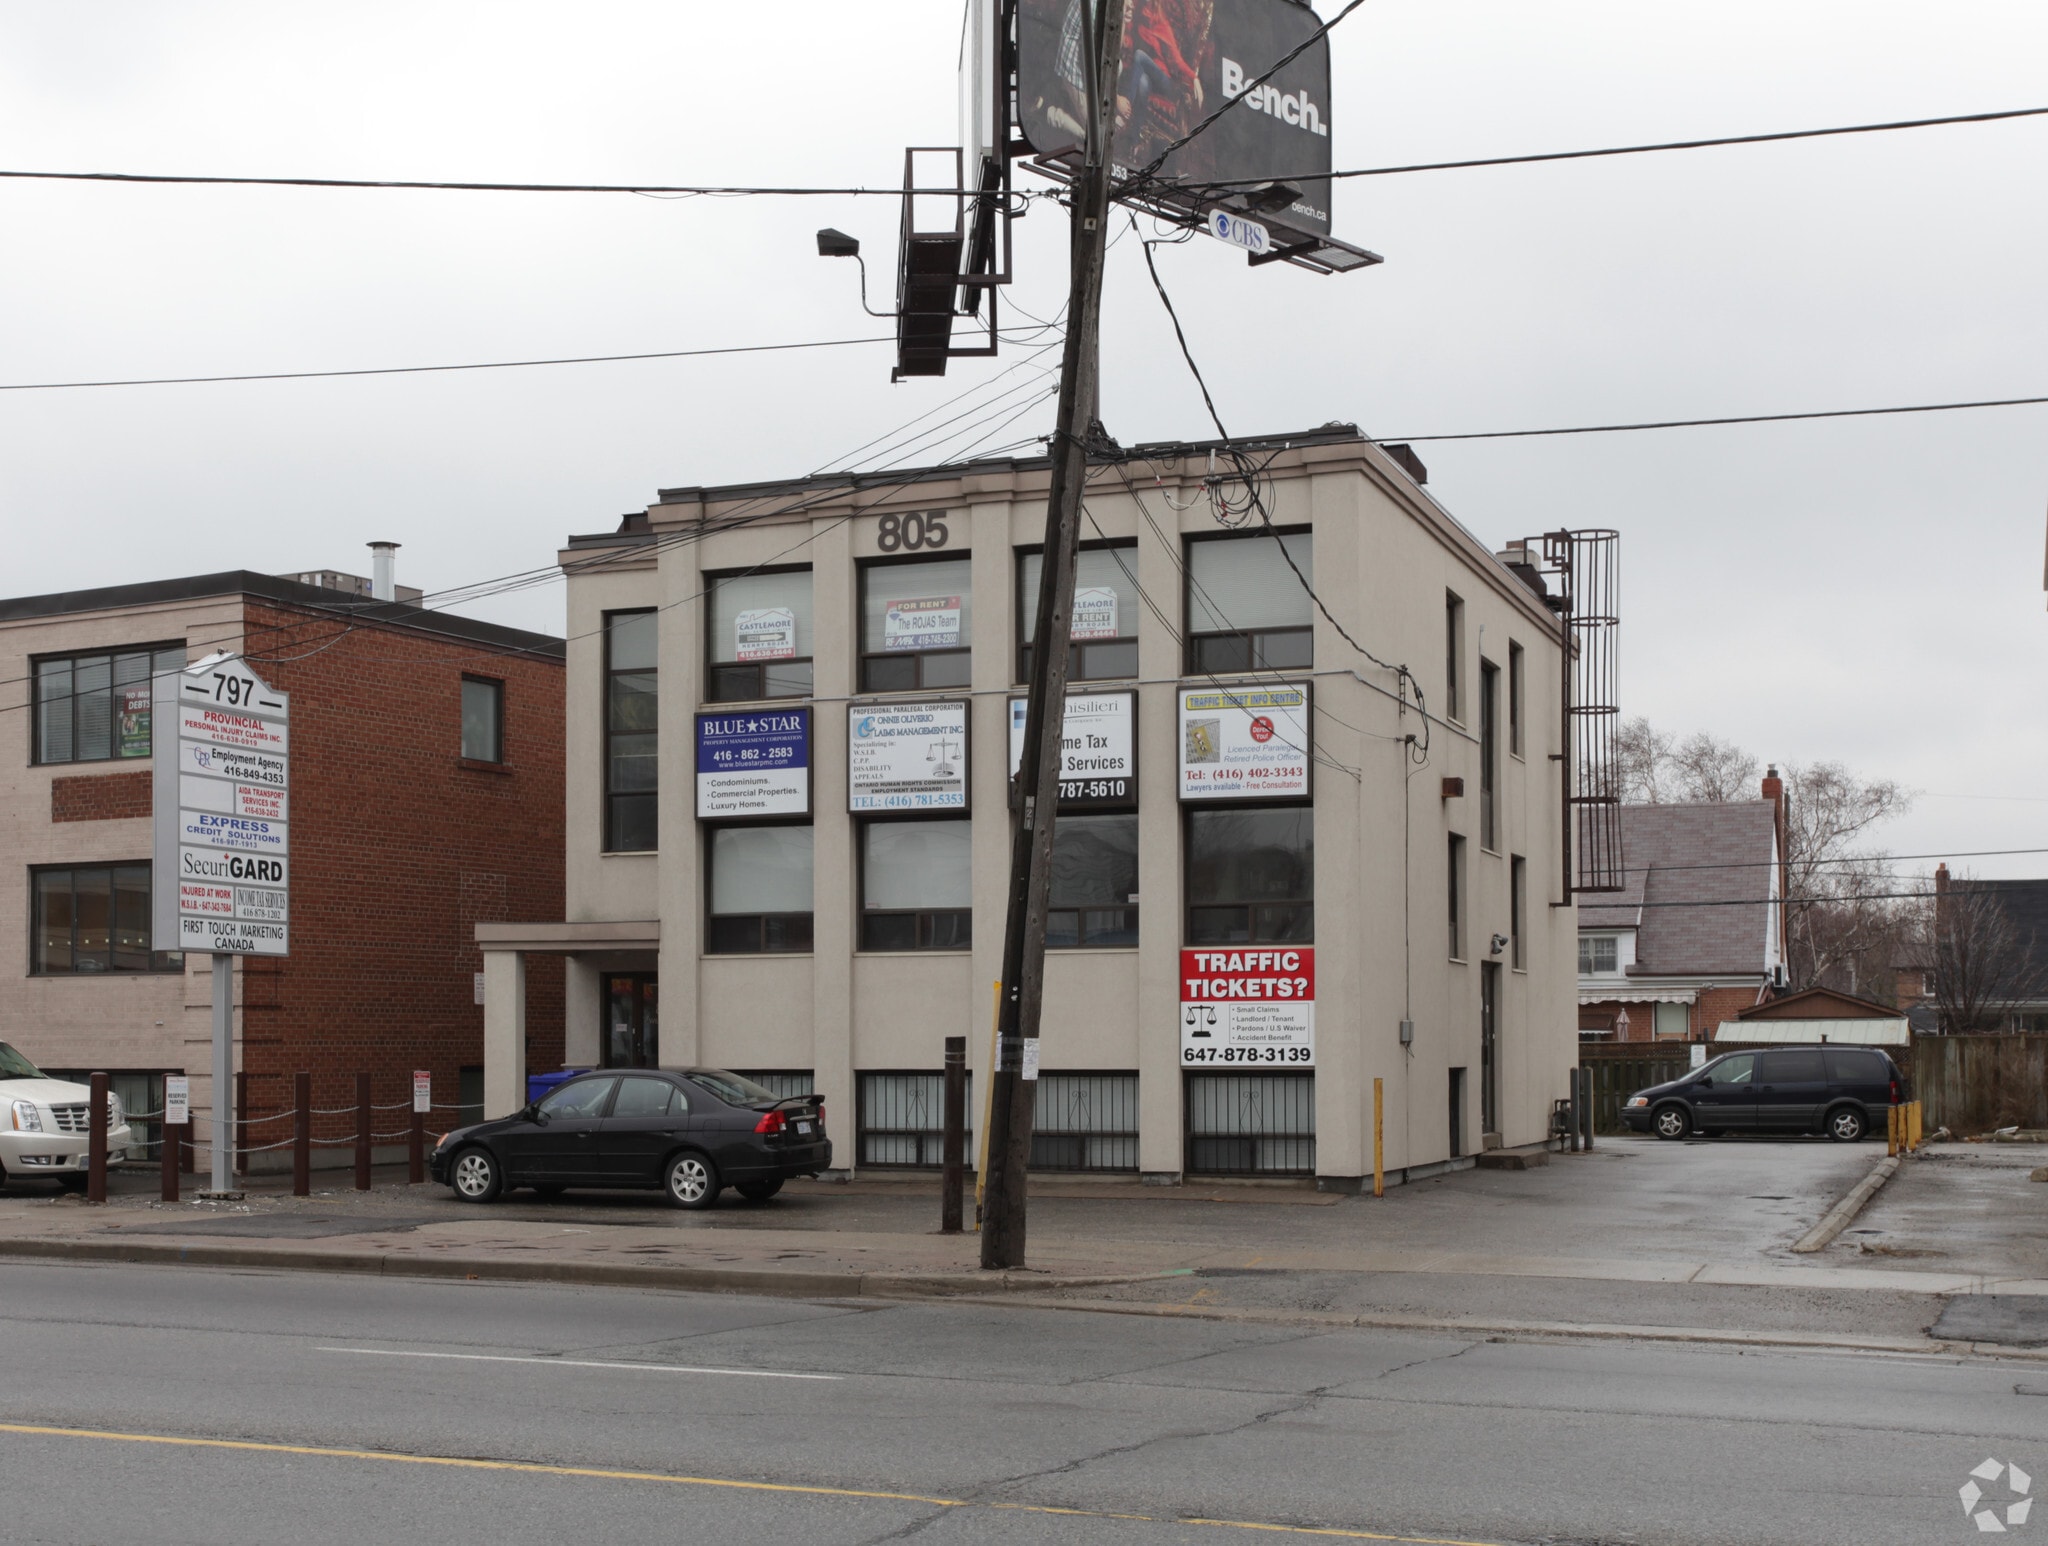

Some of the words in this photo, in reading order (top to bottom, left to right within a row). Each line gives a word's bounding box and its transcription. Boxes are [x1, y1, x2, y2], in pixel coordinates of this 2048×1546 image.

[1222, 57, 1327, 137] Bench.
[1232, 219, 1262, 250] CBS
[878, 510, 948, 552] 805
[920, 600, 946, 608] RENT
[899, 618, 910, 630] The
[913, 616, 936, 629] ROJAS
[938, 615, 957, 626] Team
[1083, 613, 1109, 621] RENT
[739, 620, 791, 630] CASTLEMORE
[886, 636, 914, 646] RE/MAX
[214, 673, 254, 706] 797
[1190, 697, 1219, 708] TRAFFIC
[1223, 696, 1248, 706] TICKET
[1251, 695, 1268, 704] INFO
[1270, 692, 1300, 703] CENTRE
[205, 711, 264, 730] PROVINCIAL
[704, 720, 745, 735] BLUE
[760, 716, 801, 733] STAR
[901, 714, 934, 723] OLIVERIO
[185, 720, 219, 732] PERSONAL
[221, 726, 243, 736] INJURY
[245, 732, 268, 740] CLAIMS
[270, 735, 282, 743] INC.
[897, 727, 948, 736] MANAGEMENT
[949, 726, 963, 734] INC.
[1086, 734, 1108, 748] Tax
[713, 751, 732, 761] 416
[741, 749, 759, 760] 862
[768, 747, 793, 758] 2583
[1228, 745, 1260, 753] Licenced
[212, 748, 256, 765] Employment
[258, 757, 284, 772] Agency
[1068, 756, 1124, 771] Services
[224, 765, 284, 784] 416-849-4353
[1185, 770, 1206, 779] Tel:
[1213, 769, 1243, 779] (416)
[1248, 767, 1303, 777] 402-3343
[1059, 780, 1125, 798] 787-5610
[1186, 784, 1212, 792] Lawyers
[1214, 782, 1241, 790] available
[1262, 780, 1302, 789] Consultation
[253, 788, 284, 799] TRANSPORT
[711, 789, 756, 798] Commercial
[243, 797, 270, 806] SERVICES
[271, 799, 281, 808] INC.
[711, 802, 737, 810] Luxury
[853, 797, 881, 808] TEL:
[885, 795, 912, 807] (416)
[915, 794, 963, 805] 781-5353
[200, 815, 269, 832] EXPRESS
[187, 826, 222, 836] CREDIT
[228, 831, 280, 843] SOLUTIONS
[211, 837, 257, 848] 416-987-1913
[184, 853, 283, 882] SecuriGARD
[181, 886, 205, 897] INJURED
[207, 888, 214, 897] AT
[215, 889, 231, 899] WORK
[181, 900, 198, 910] W.S.I.B.
[243, 908, 253, 916] 416
[184, 920, 203, 933] FIRST
[209, 922, 236, 936] TOUCH
[240, 924, 283, 939] MARKETING
[215, 937, 255, 950] CANADA
[1194, 952, 1300, 972] TRAFFIC
[1186, 977, 1308, 998] TICKETS?
[1184, 1047, 1311, 1061] 647-878-3139
